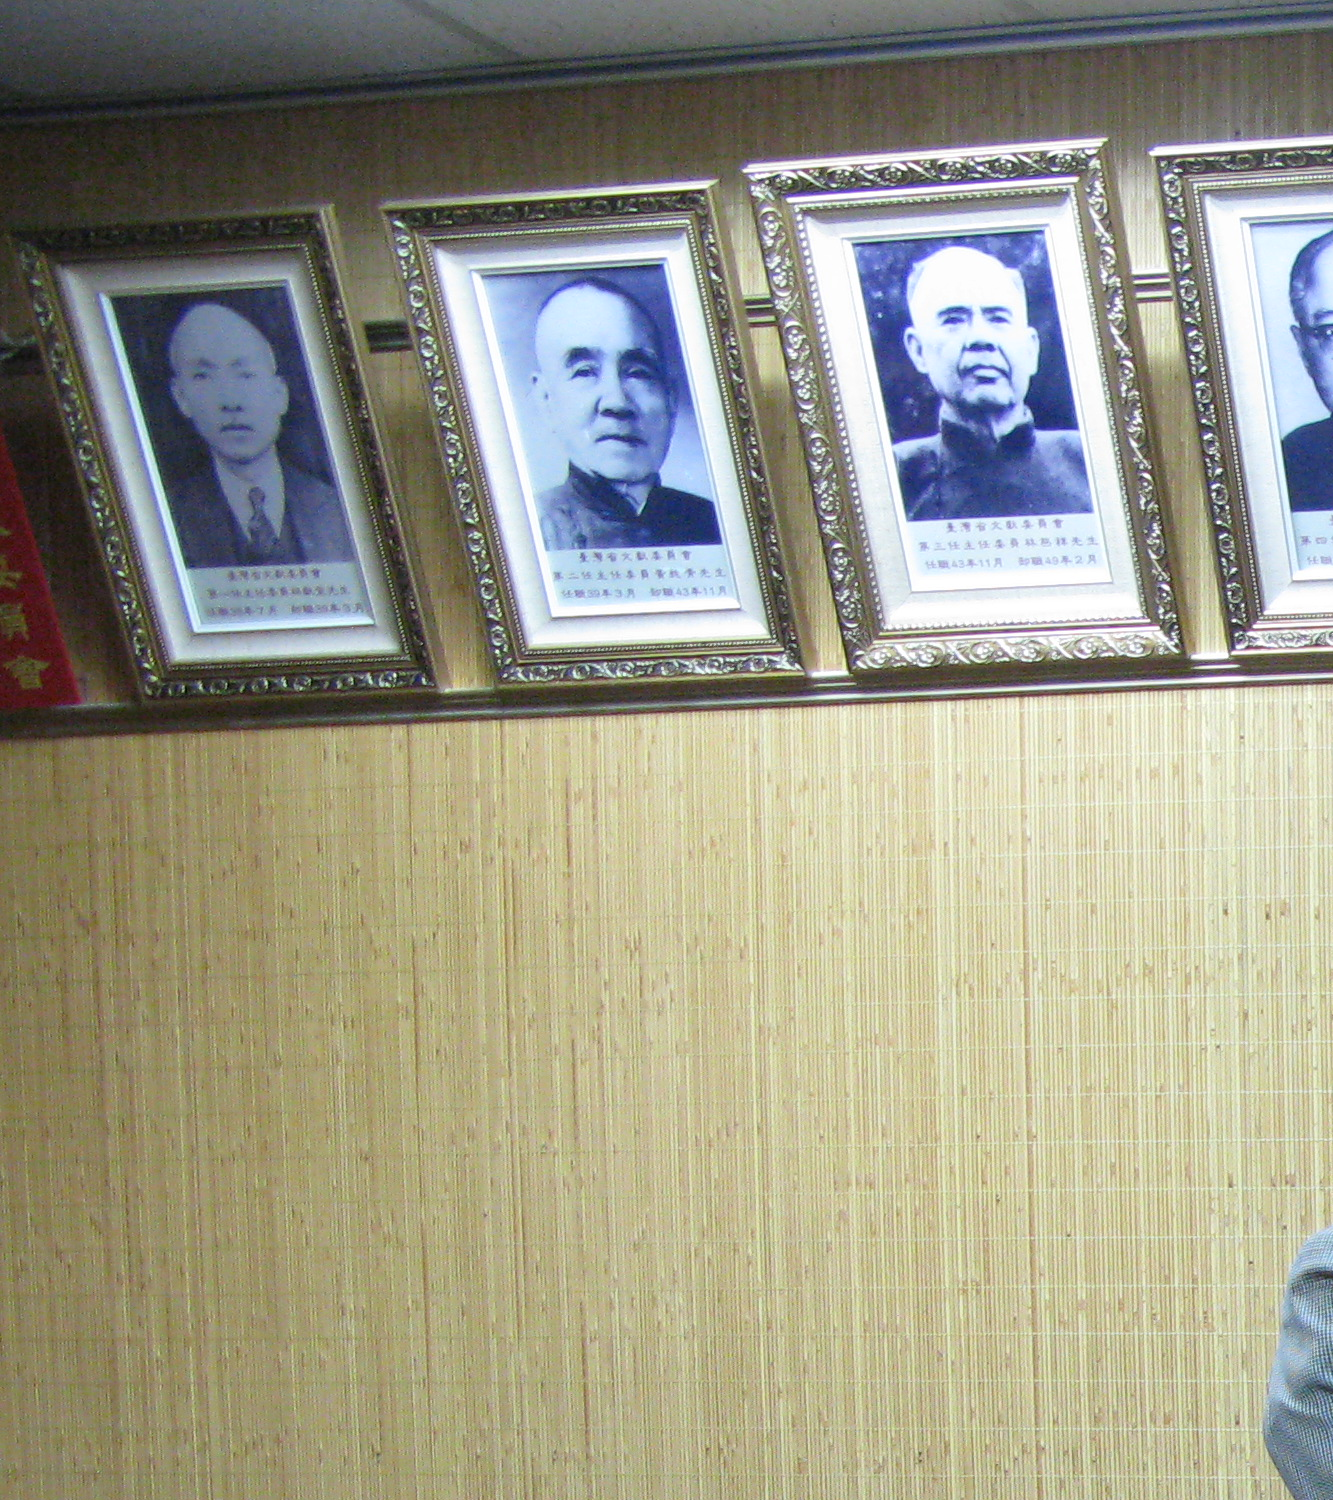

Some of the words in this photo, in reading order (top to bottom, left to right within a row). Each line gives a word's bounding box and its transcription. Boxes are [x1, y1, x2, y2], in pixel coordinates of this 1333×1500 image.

[946, 518, 1064, 534] 臺灣省文獻委員會
[579, 549, 692, 564] 臺灣省文獻委員會
[924, 558, 1004, 570] 任職43年11月
[1018, 554, 1098, 567] 卸職49年2月
